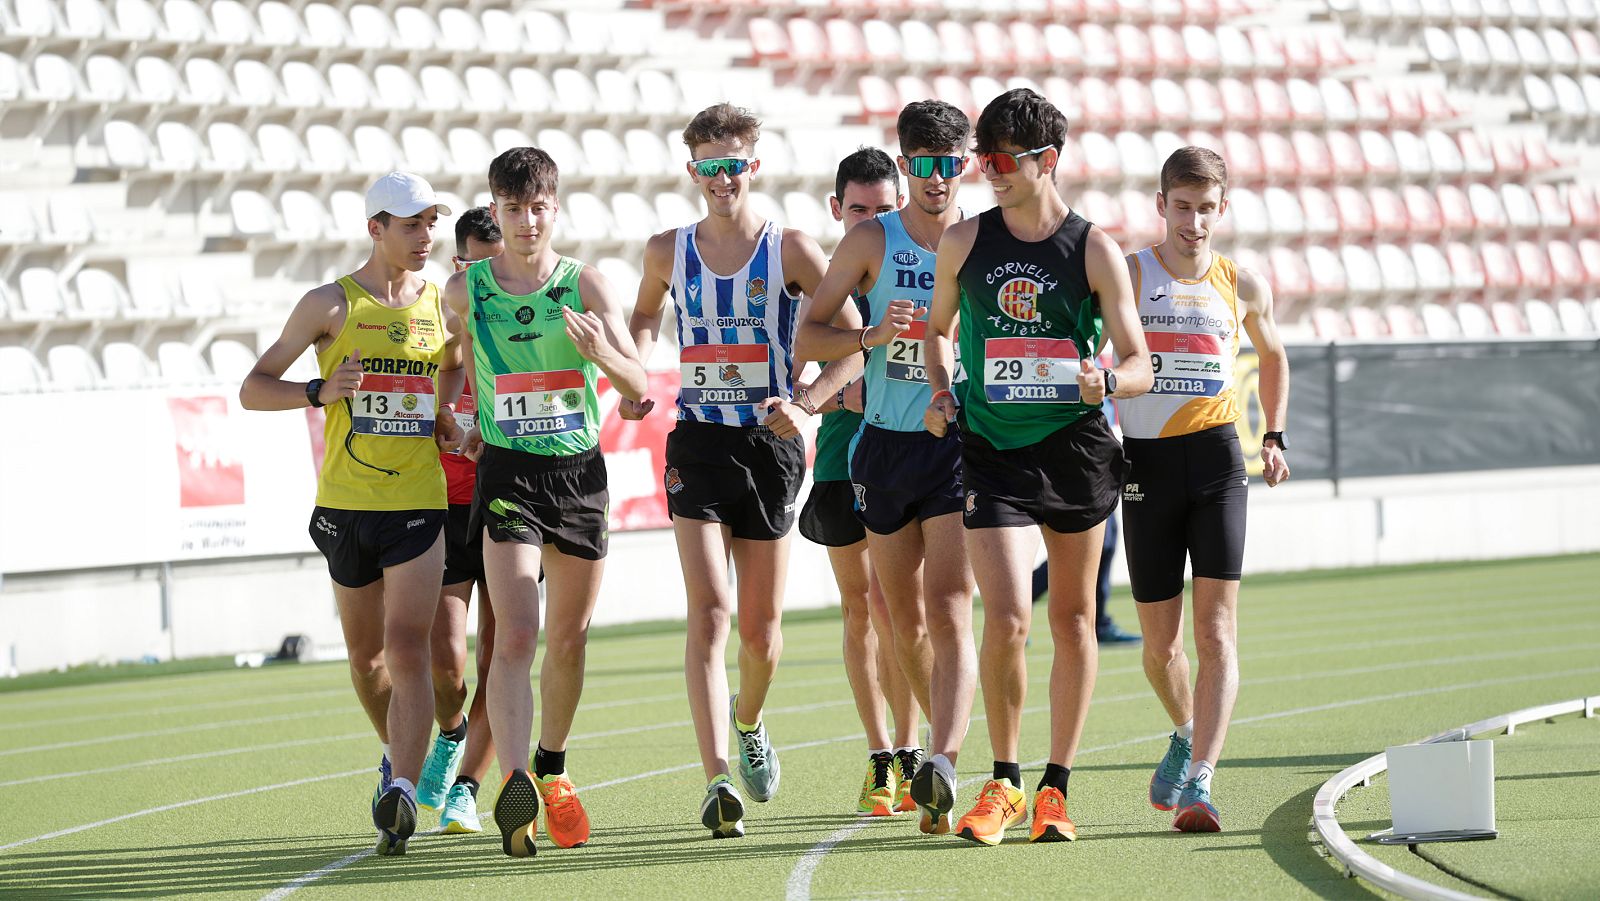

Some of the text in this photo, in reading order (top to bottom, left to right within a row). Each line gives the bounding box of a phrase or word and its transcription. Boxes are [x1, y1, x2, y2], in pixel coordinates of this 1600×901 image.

[895, 269, 934, 291] ne
[356, 322, 387, 330] Alcampo
[892, 340, 919, 363] 21
[358, 357, 424, 376] CORPIO
[993, 359, 1023, 381] 29
[1204, 361, 1221, 370] PA
[694, 366, 706, 386] 5
[362, 394, 389, 415] 13
[503, 395, 527, 417] 11
[538, 402, 558, 413] Jaén
[393, 410, 425, 419] Alcampo
[1125, 483, 1140, 493] PA
